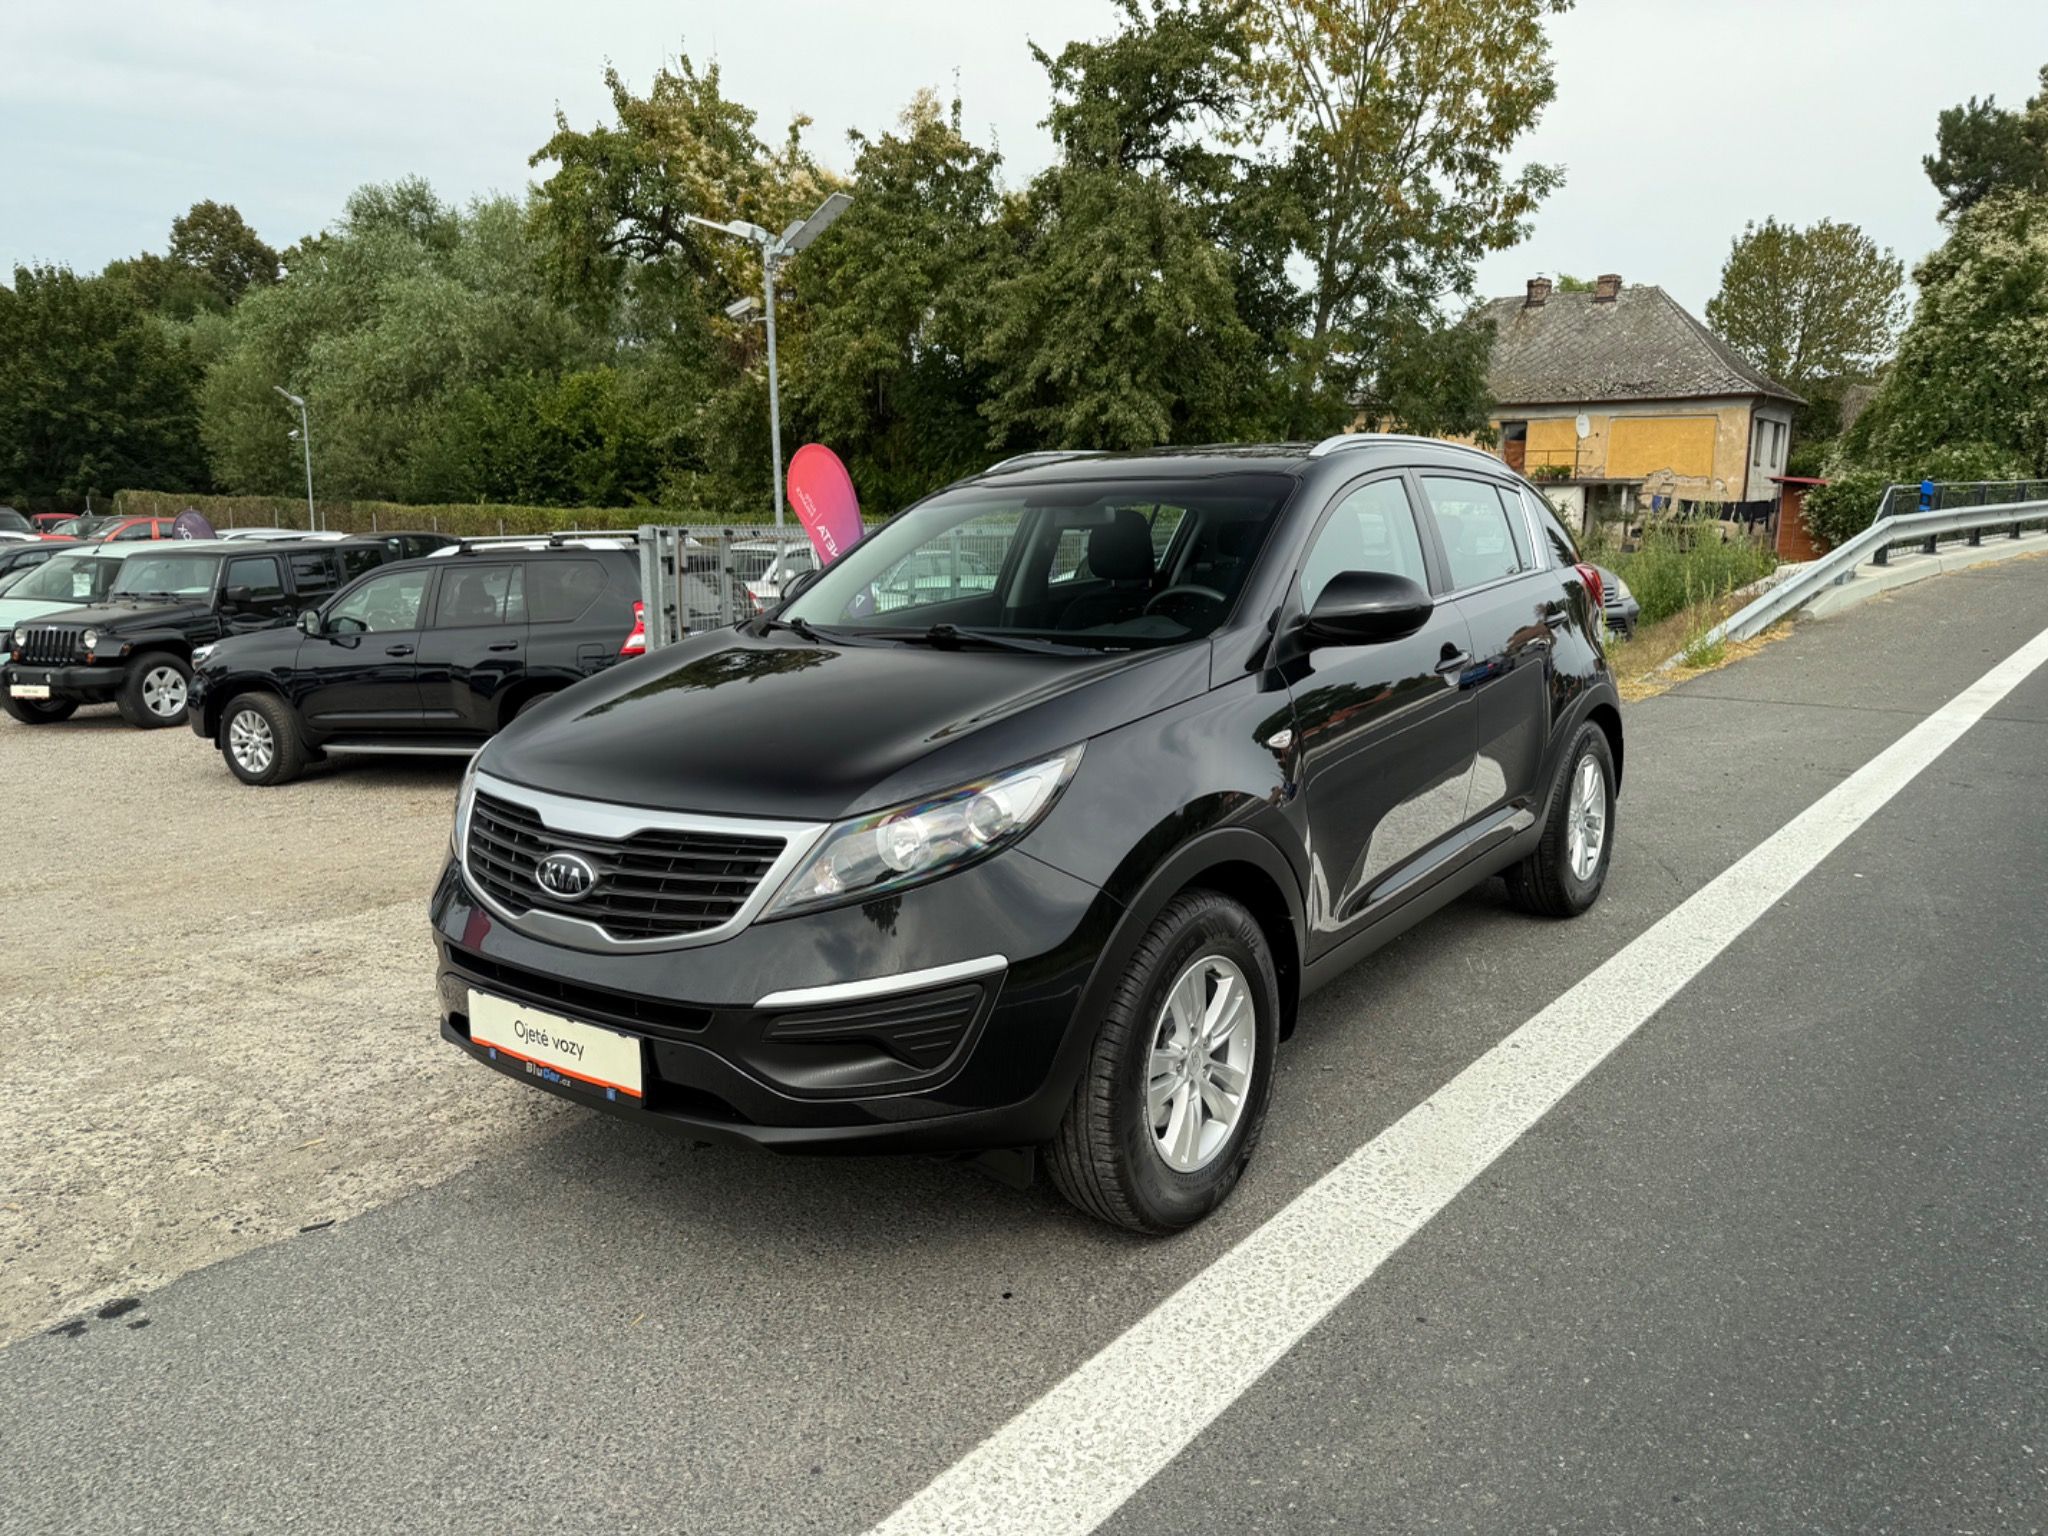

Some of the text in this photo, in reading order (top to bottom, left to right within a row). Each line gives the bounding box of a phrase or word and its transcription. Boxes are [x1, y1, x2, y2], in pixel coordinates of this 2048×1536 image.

[544, 861, 582, 891] KIA
[514, 1020, 585, 1062] Ojeté vozy
